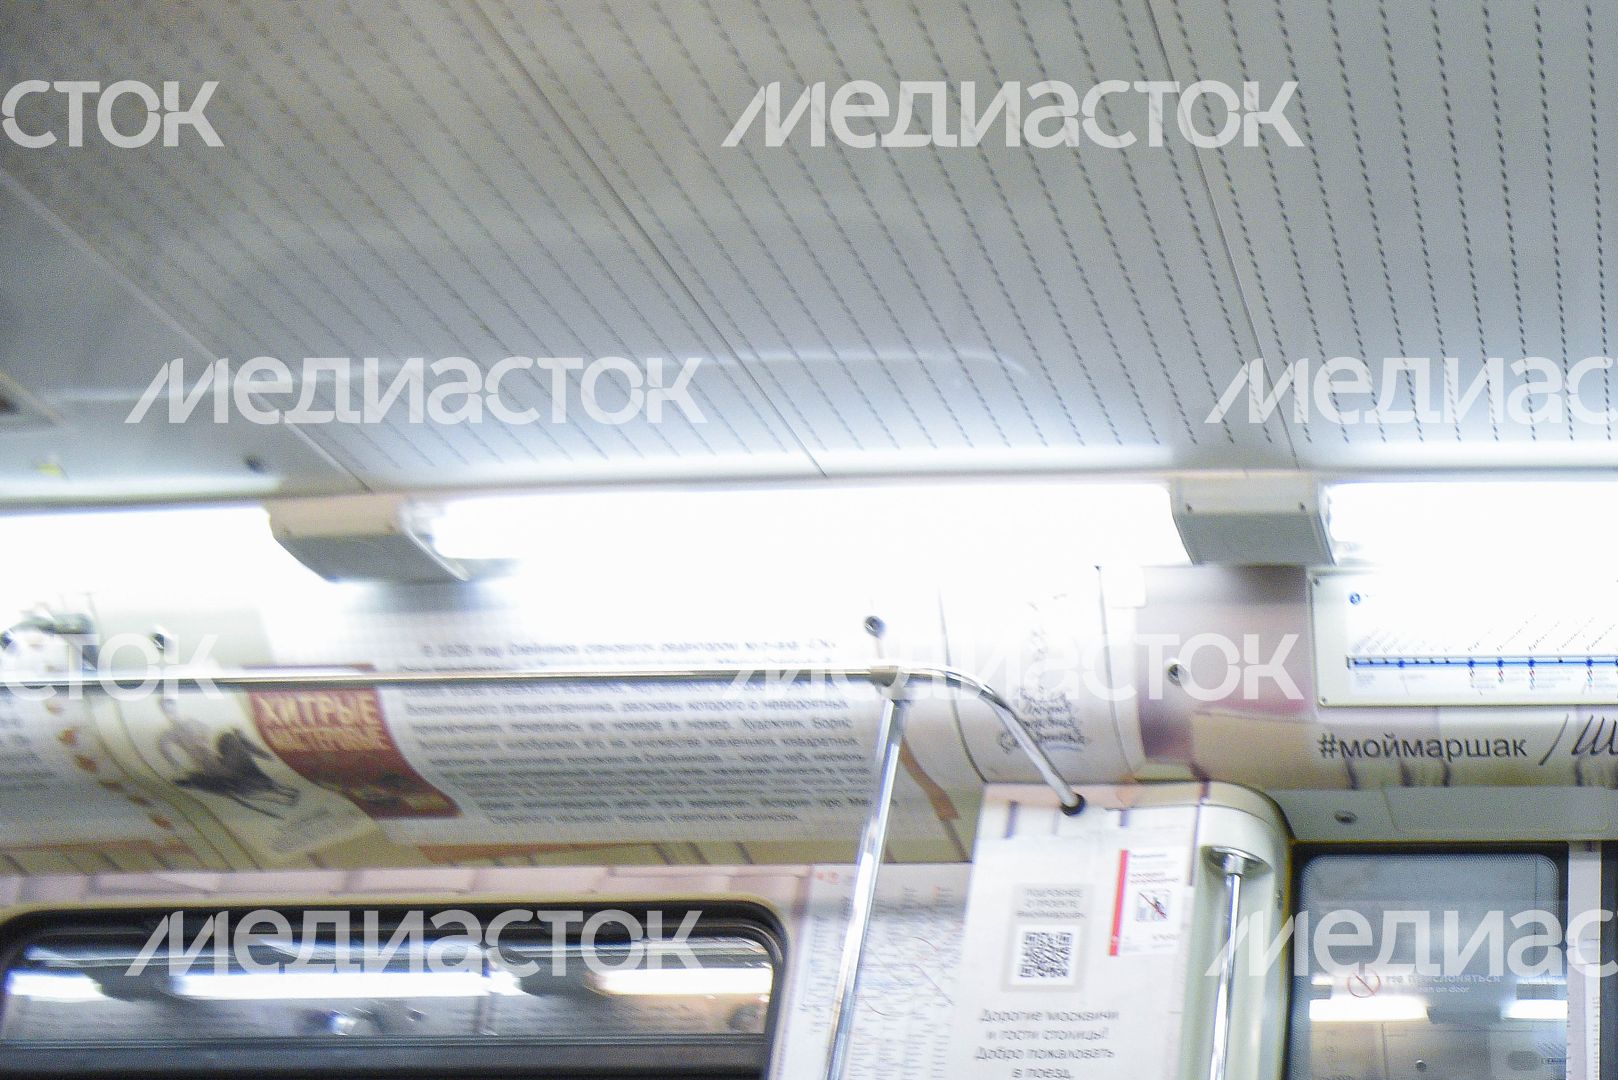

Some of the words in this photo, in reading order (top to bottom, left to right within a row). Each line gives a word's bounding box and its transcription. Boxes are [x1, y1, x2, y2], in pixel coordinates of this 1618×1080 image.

[1317, 731, 1529, 762] #моймаршак
[981, 1009, 1043, 1024] Дорогие
[1048, 1010, 1119, 1022] москвичи
[1000, 1029, 1039, 1041] гости
[975, 1046, 1024, 1061] Добро
[1028, 1048, 1115, 1060] пожаловать
